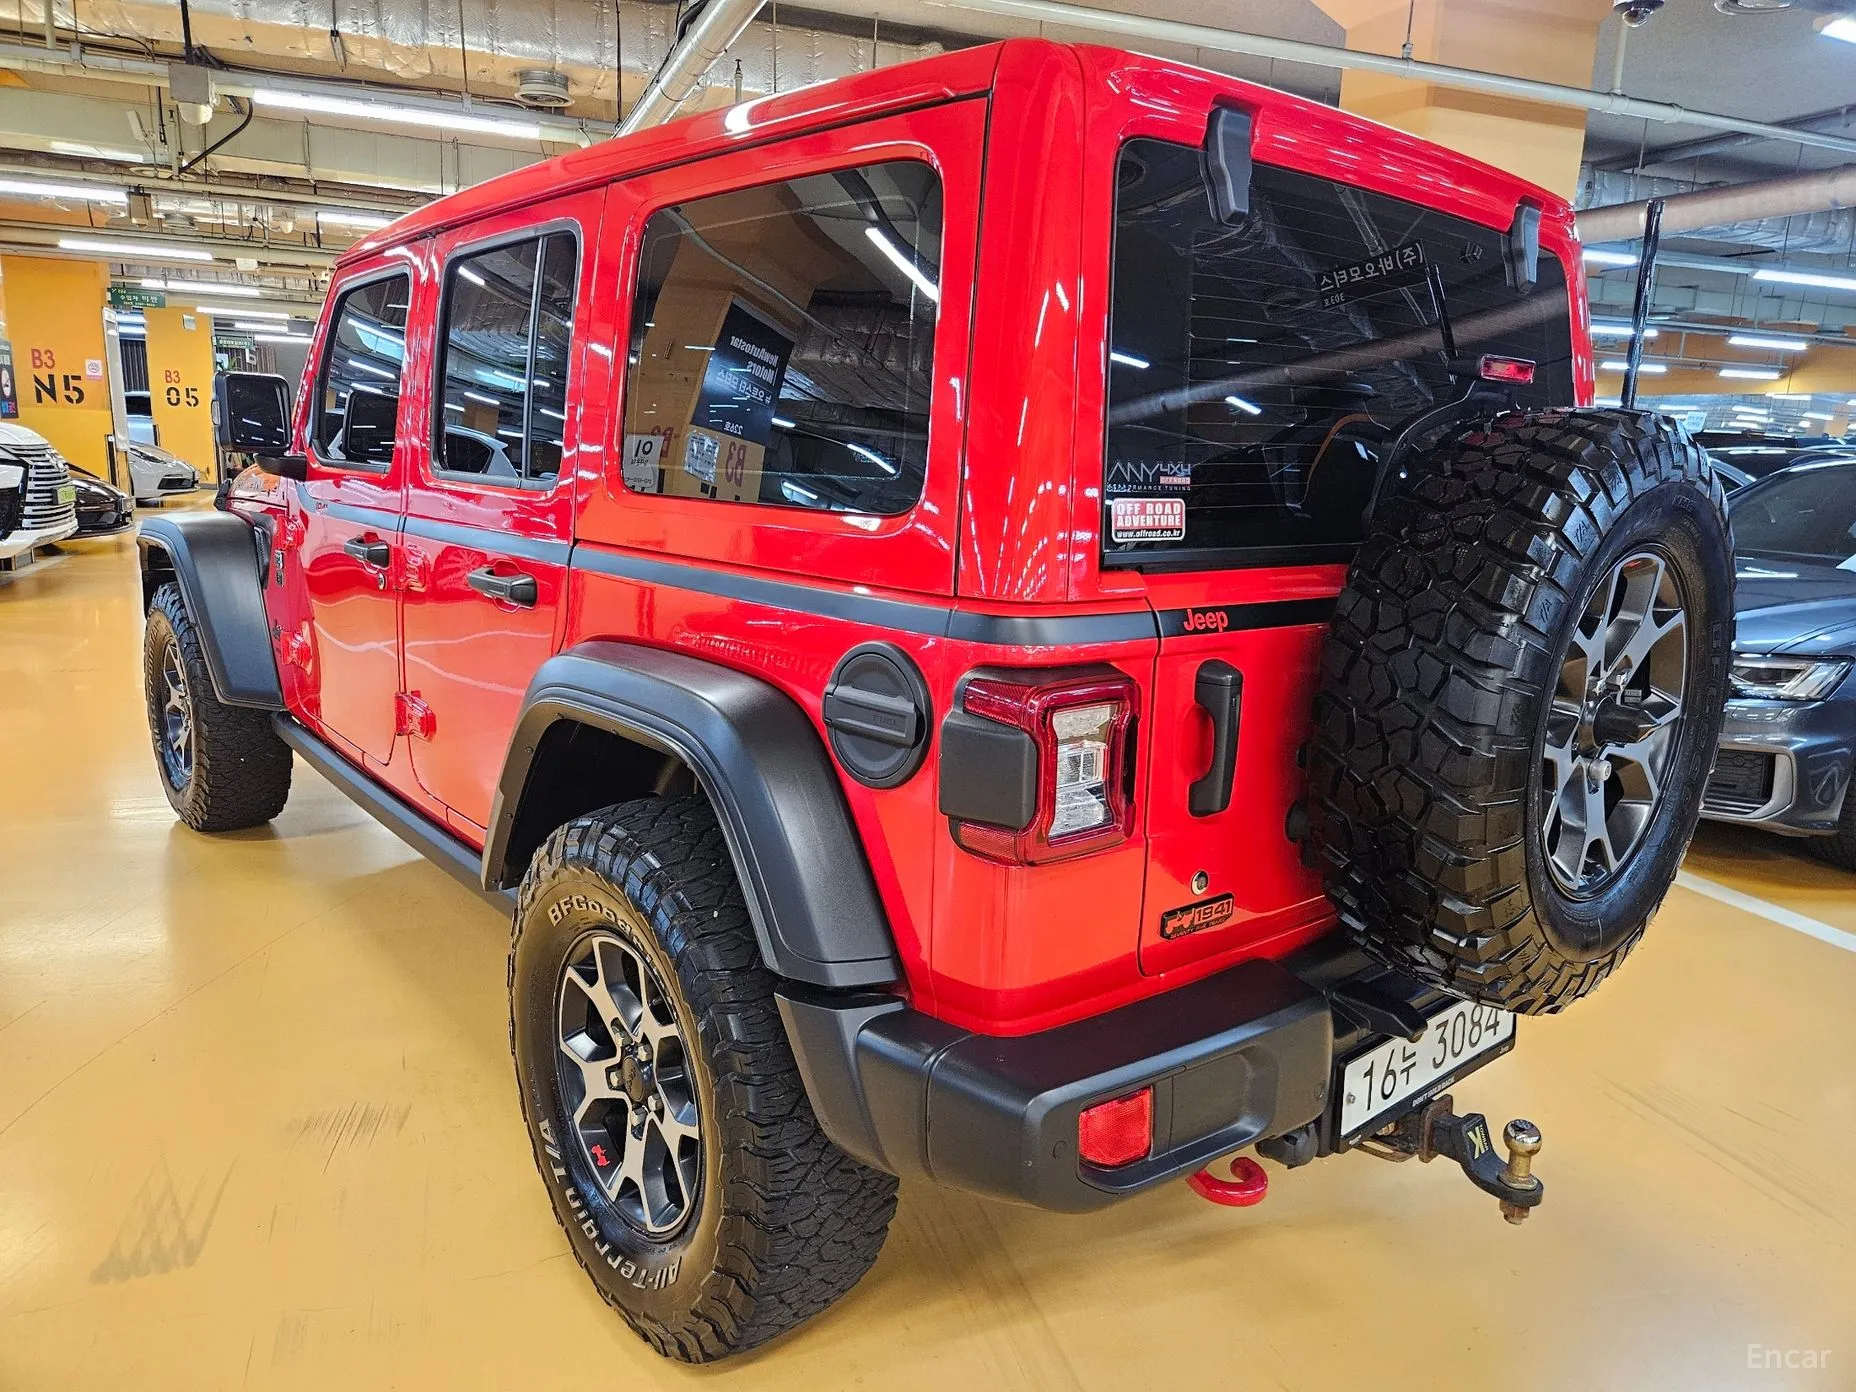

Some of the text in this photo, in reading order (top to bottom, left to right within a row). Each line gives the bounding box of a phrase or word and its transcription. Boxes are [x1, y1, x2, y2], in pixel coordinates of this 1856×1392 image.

[30, 348, 56, 370] B3
[164, 370, 181, 384] B3
[34, 374, 85, 405] N5
[1164, 484, 1191, 492] TUNING
[1117, 502, 1181, 515] OFF ROAD
[1117, 514, 1181, 527] ADVENTURE
[1117, 528, 1181, 539] www.offroad.co.kr
[1183, 608, 1229, 633] Jeep
[1196, 900, 1231, 922] 1941
[1363, 1003, 1500, 1111] 16누 3084
[538, 1118, 682, 1291] All-Terrain T/A
